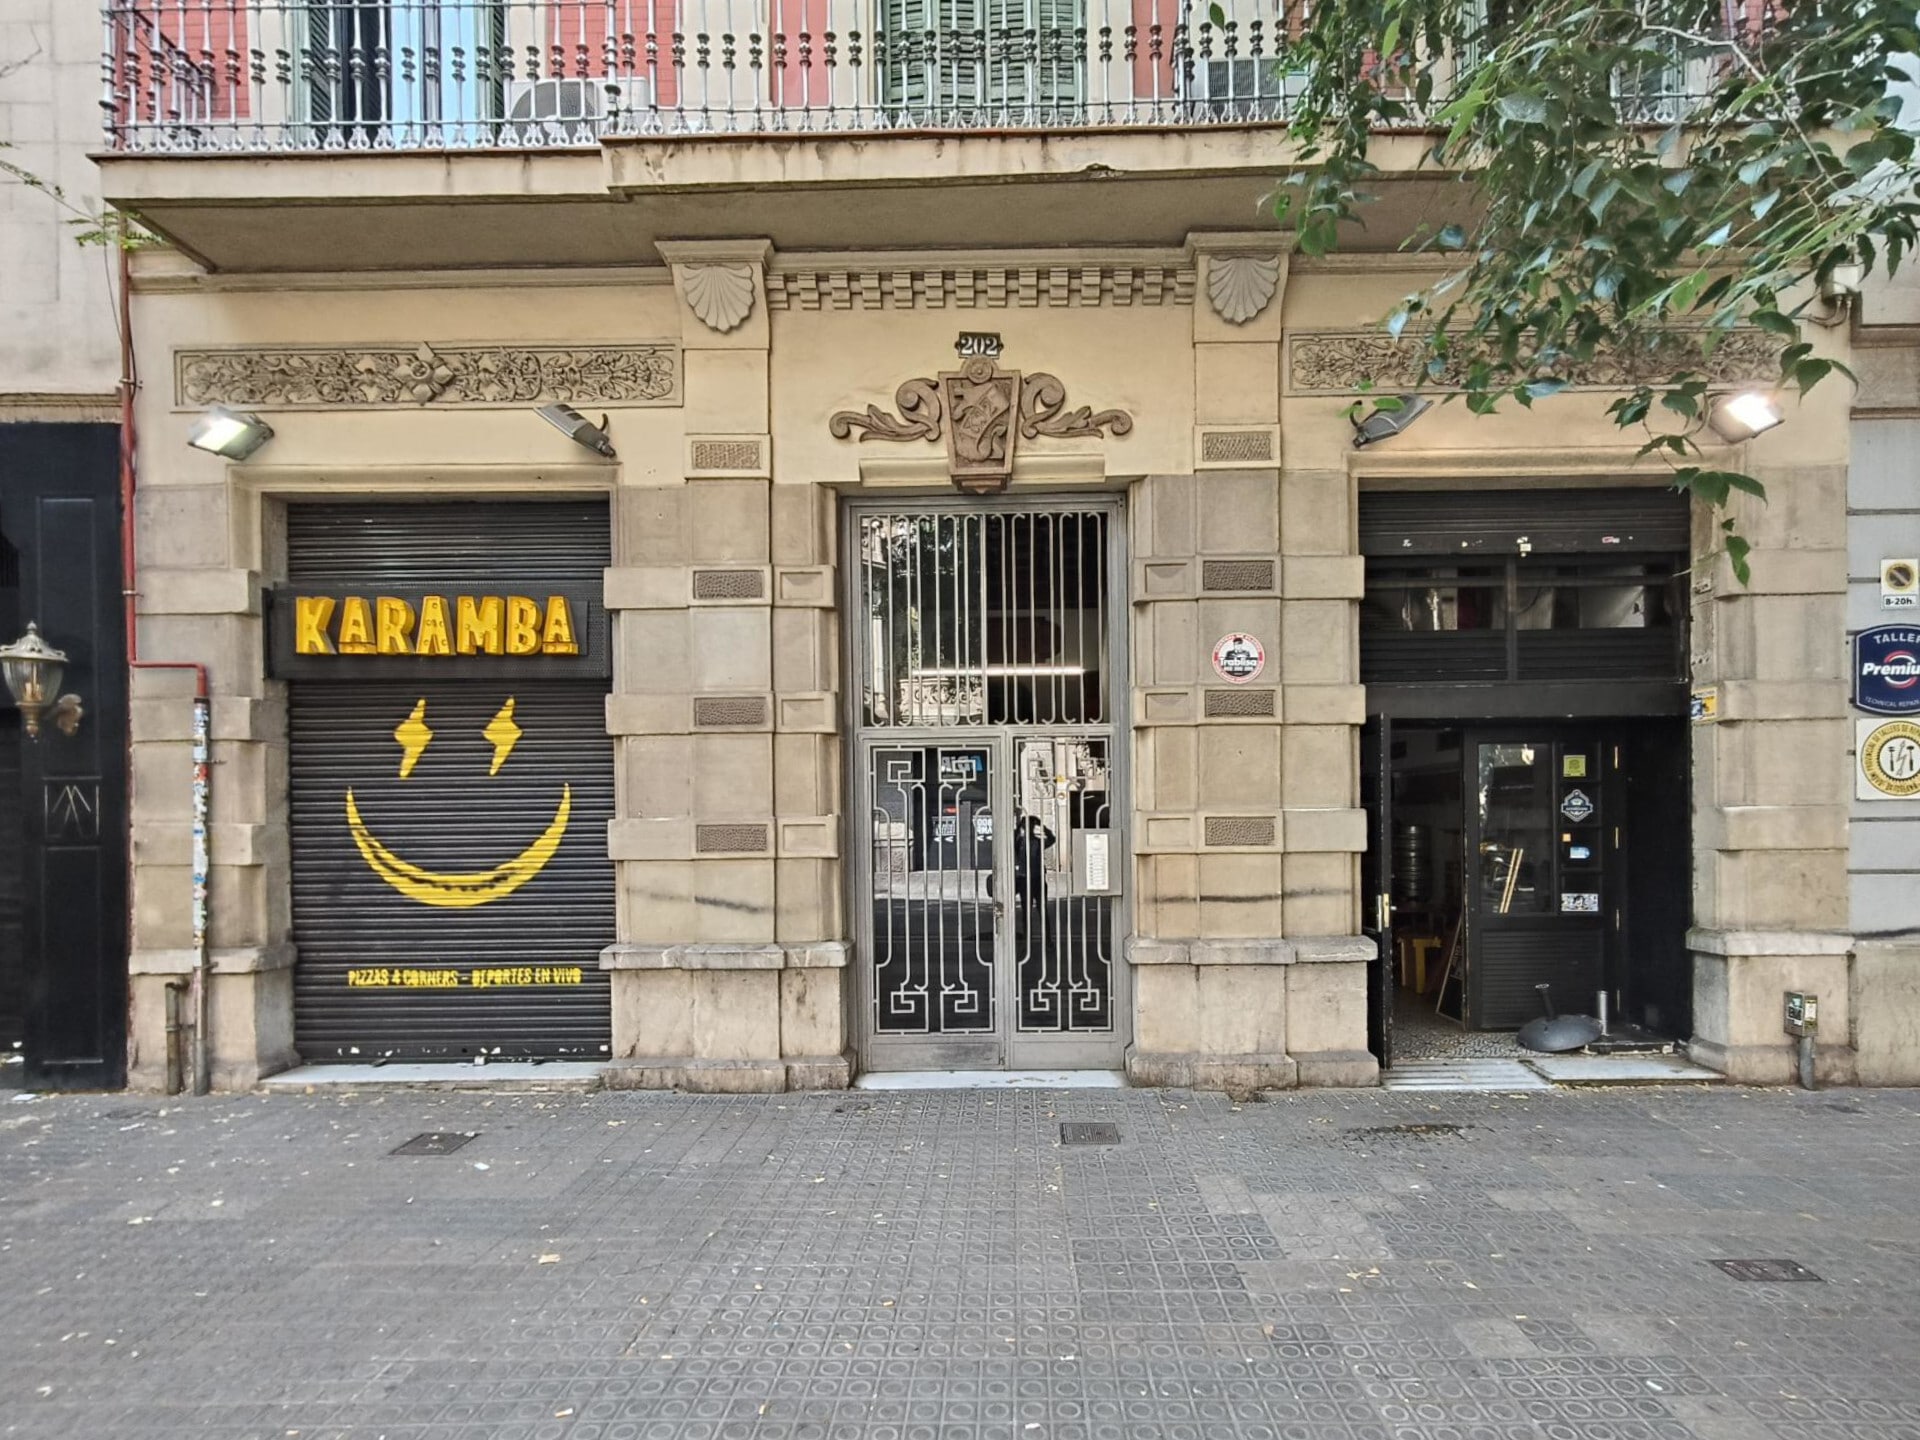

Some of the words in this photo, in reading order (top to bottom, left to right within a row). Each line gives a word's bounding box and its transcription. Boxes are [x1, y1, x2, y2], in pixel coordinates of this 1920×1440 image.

[960, 336, 998, 355] 202
[296, 596, 579, 655] KARAMBA
[348, 968, 389, 986] PIZZAS
[391, 969, 400, 984] 4
[402, 969, 459, 987] CORNERS
[472, 967, 532, 988] DEPORTES
[534, 967, 550, 984] EN
[553, 967, 582, 984] VIVO
